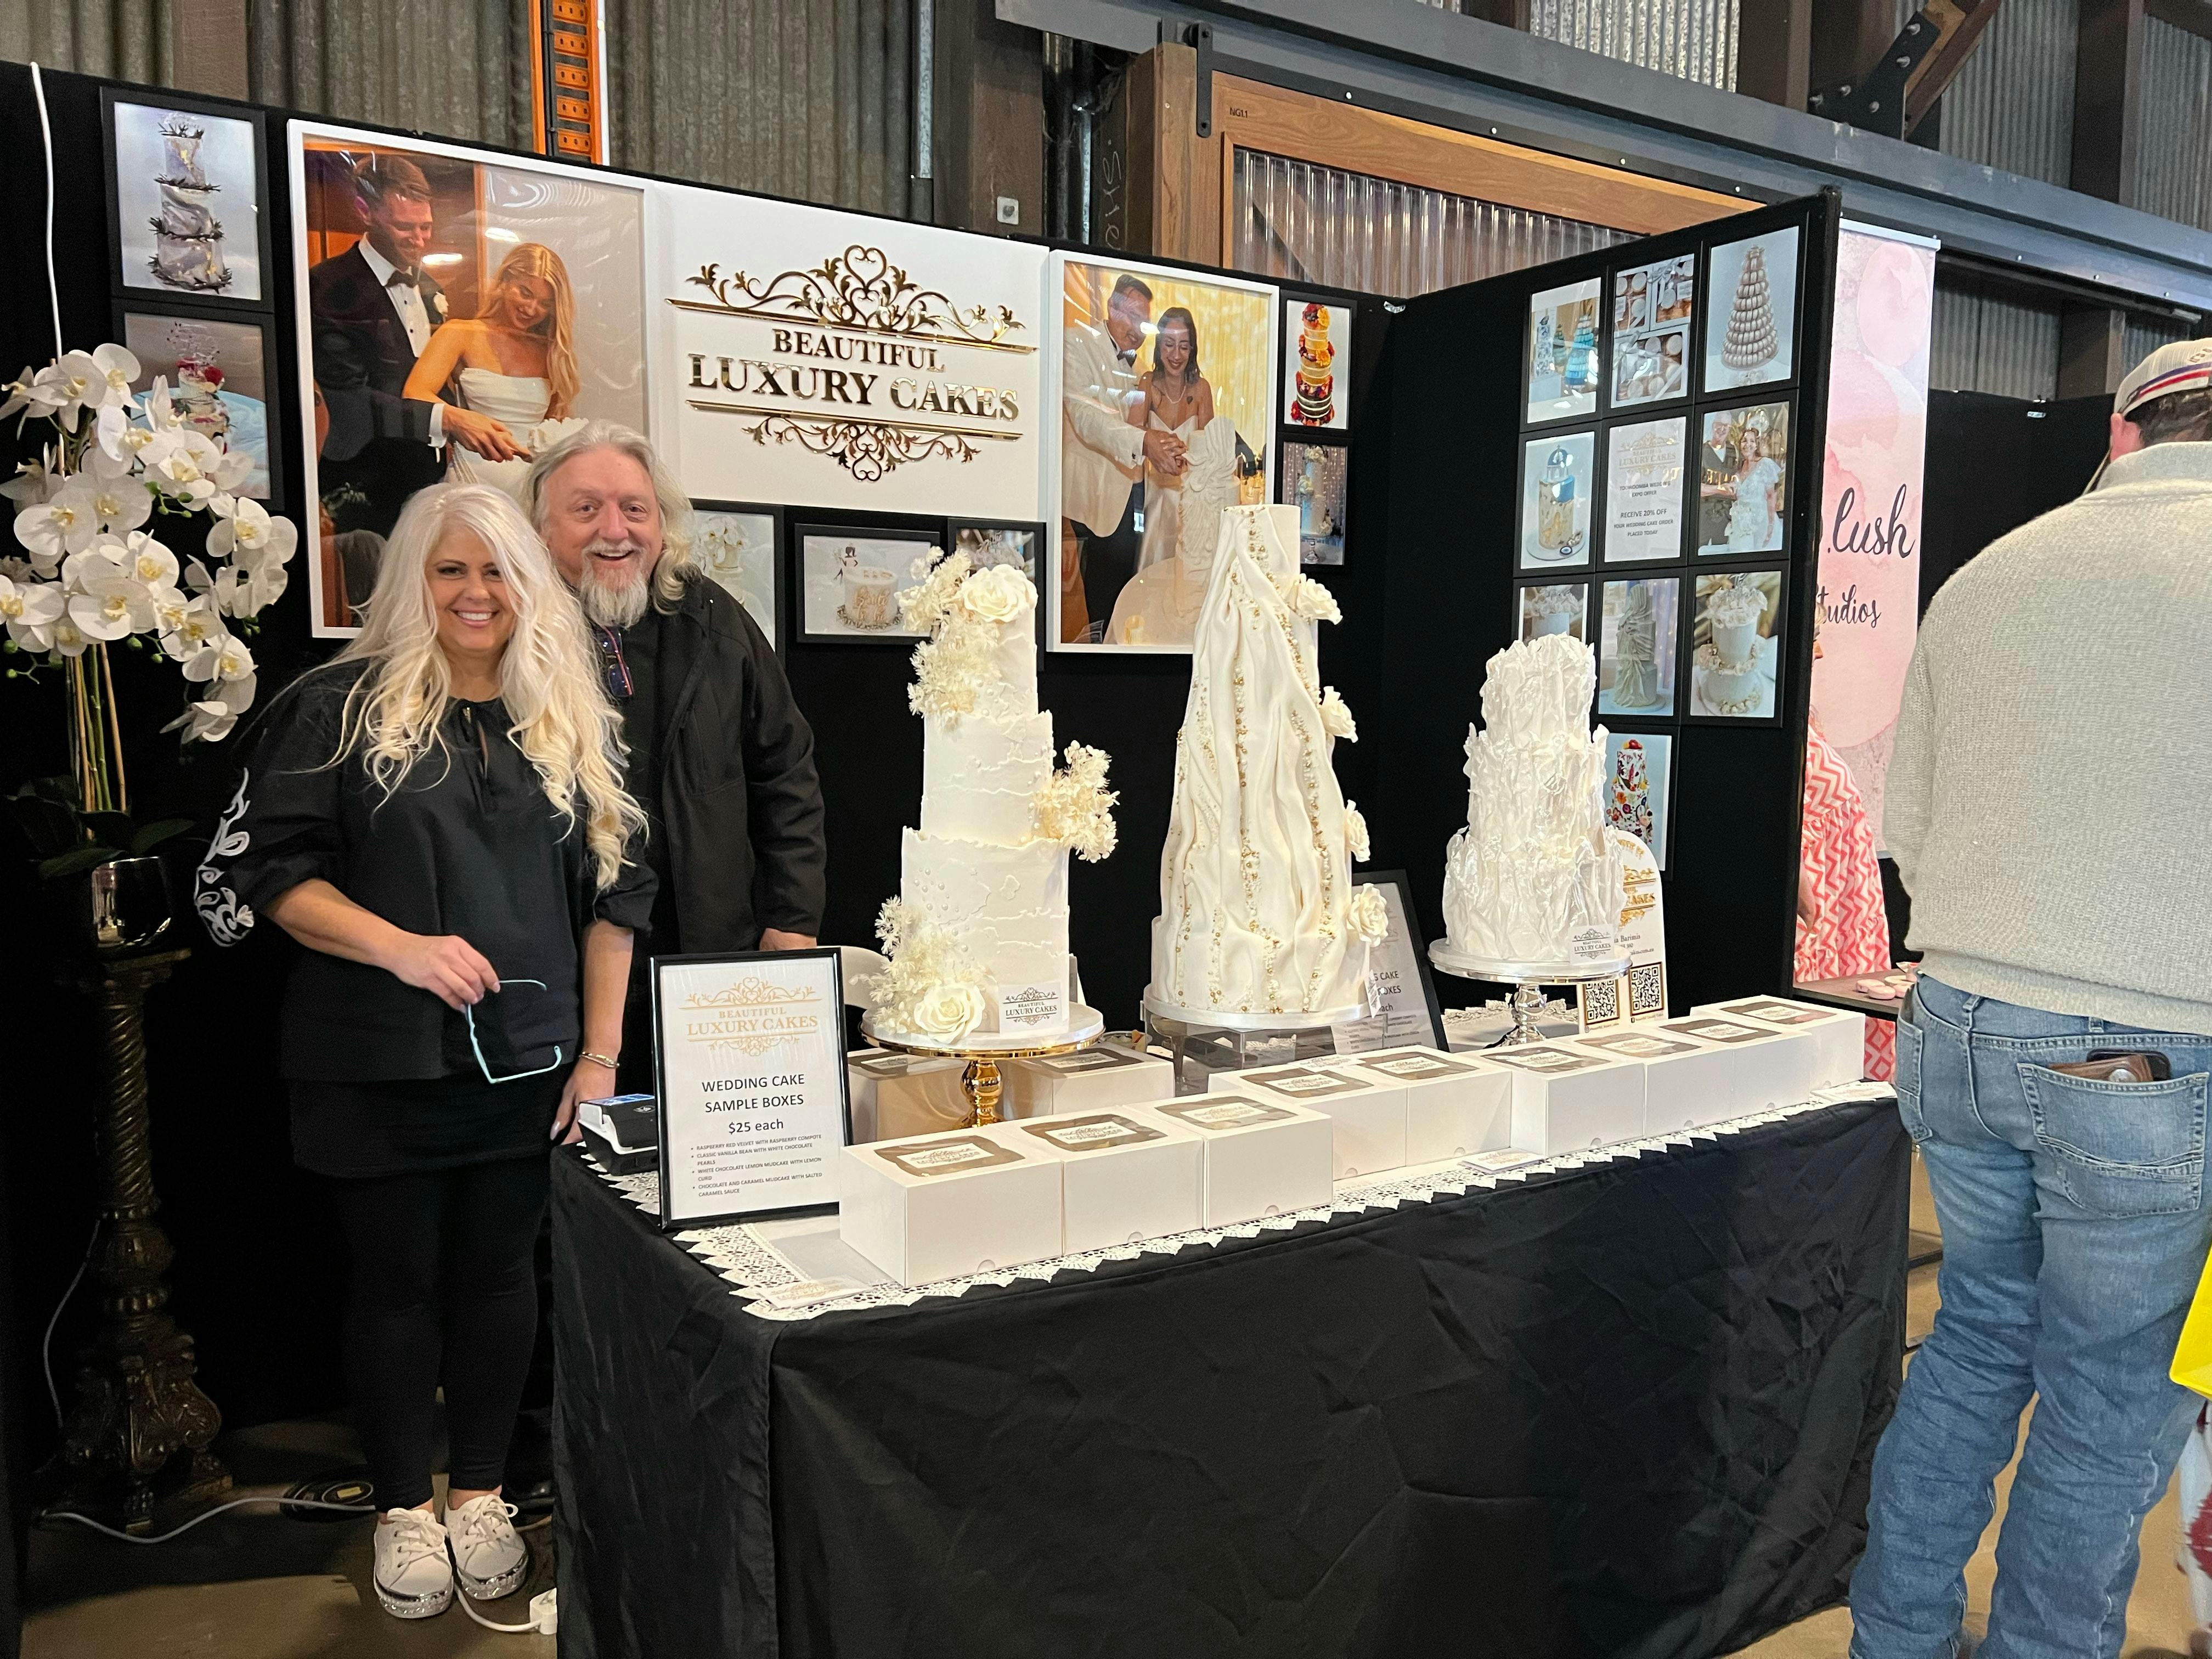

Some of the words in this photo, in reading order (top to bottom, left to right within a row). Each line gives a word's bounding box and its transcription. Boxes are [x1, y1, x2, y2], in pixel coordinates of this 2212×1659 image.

[772, 329, 946, 373] BEAUTIFUL
[687, 353, 878, 406] LUXURY
[889, 377, 1019, 422] CAKES
[1620, 456, 1650, 466] LUXURY
[1651, 453, 1677, 462] CAKES
[1620, 510, 1643, 518] RECEIVE
[1816, 584, 1882, 628] tudios
[1380, 970, 1399, 980] CAKE
[719, 1007, 787, 1018] BEAUTIFUL
[1006, 1008, 1034, 1016] LUXURY
[1035, 1005, 1057, 1013] CAKES
[1379, 1003, 1393, 1012] ach
[687, 1019, 759, 1036] LUXURY
[763, 1015, 817, 1030] CAKES
[702, 1077, 768, 1092] WEDDING
[772, 1074, 805, 1087] CAKE
[705, 1098, 758, 1113] SAMPLE
[763, 1094, 804, 1108] BOXES
[729, 1121, 751, 1135] $25
[755, 1119, 783, 1131] each
